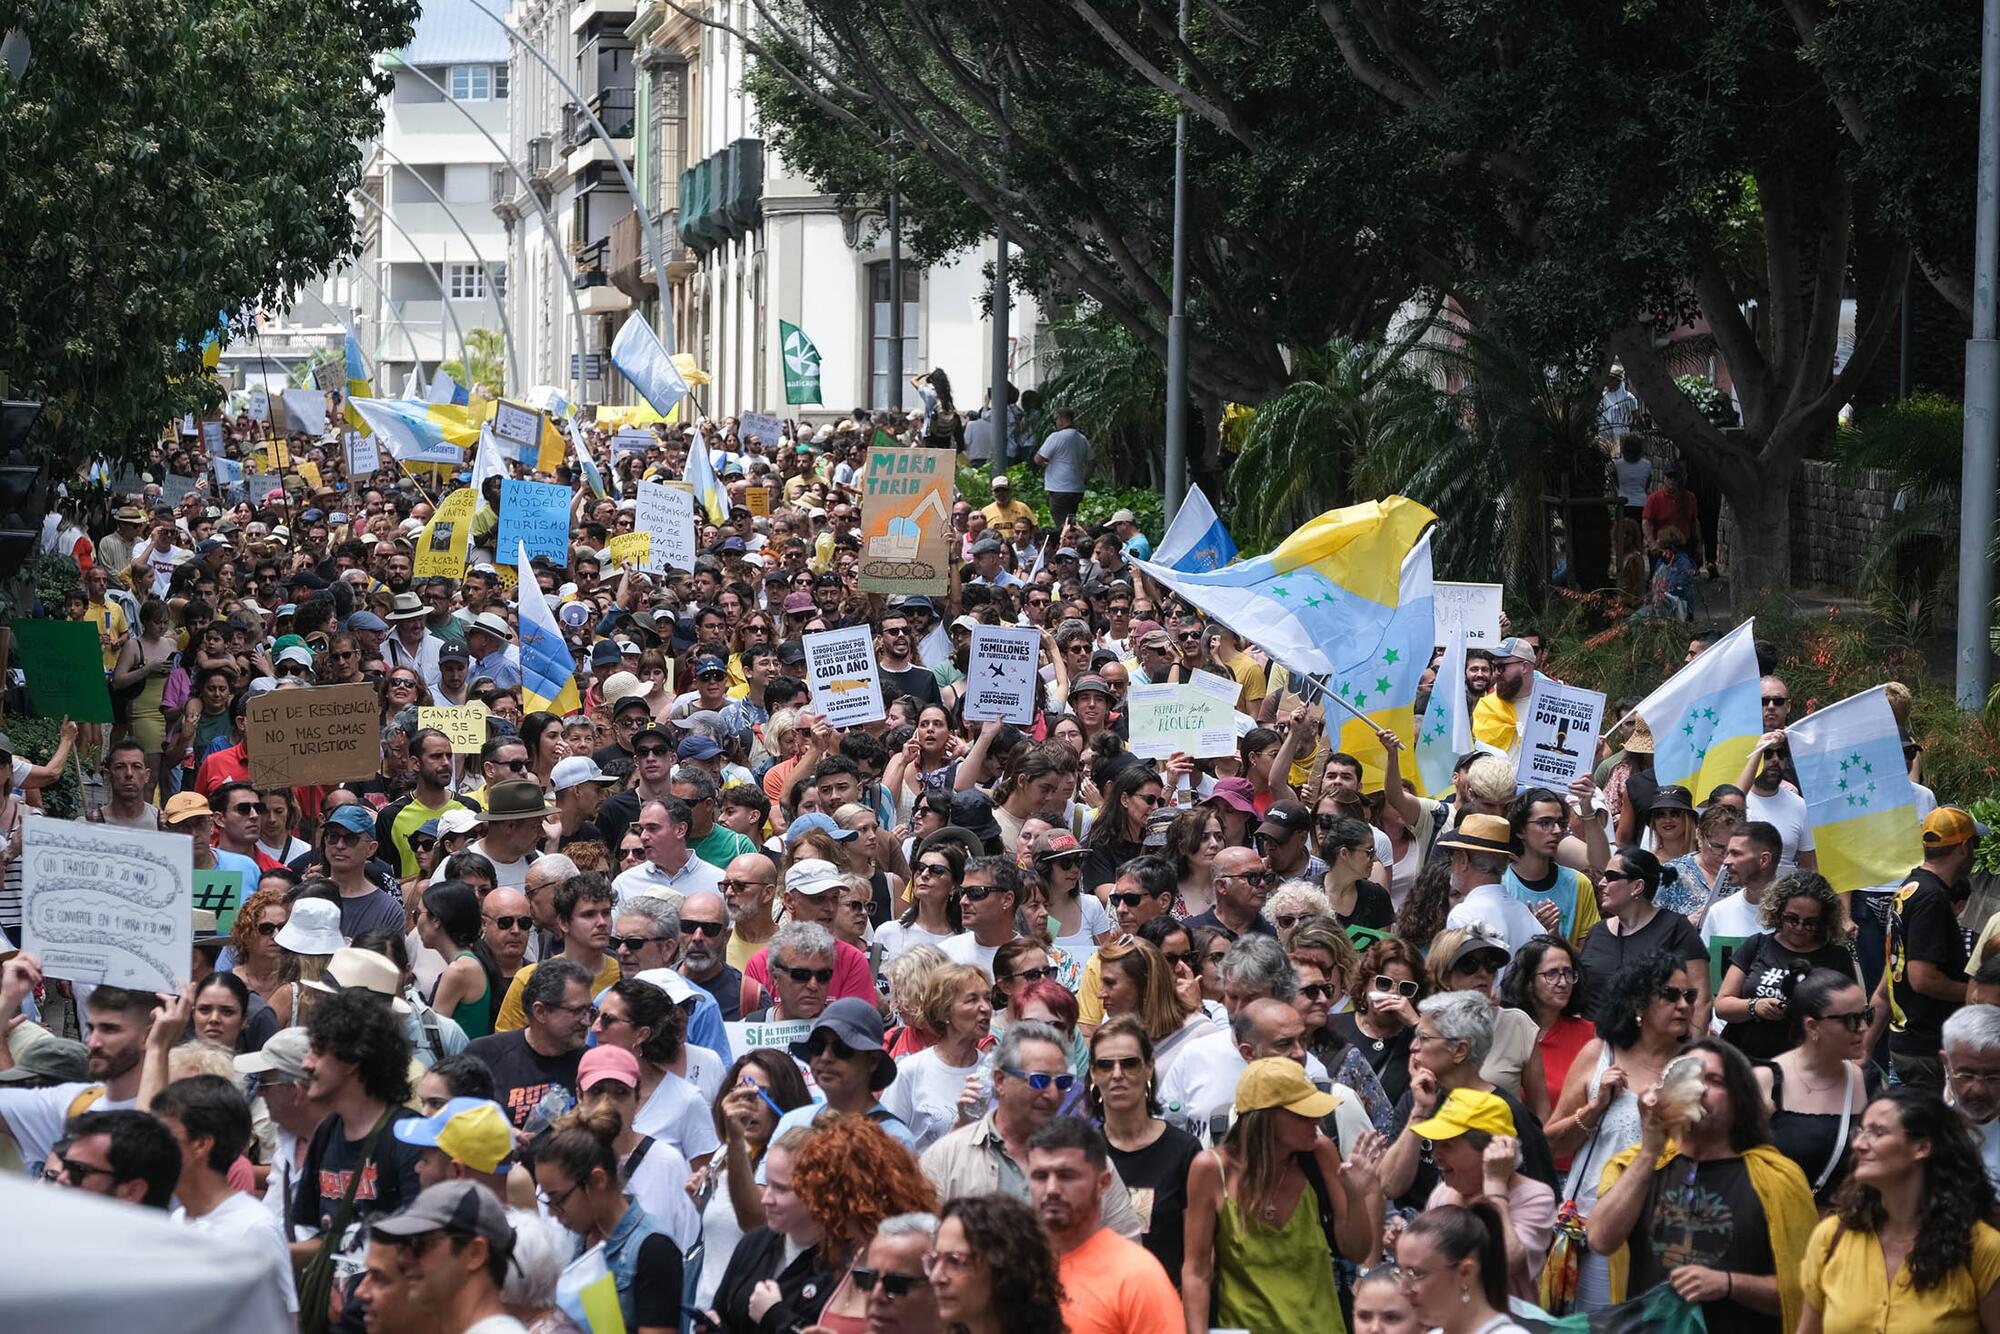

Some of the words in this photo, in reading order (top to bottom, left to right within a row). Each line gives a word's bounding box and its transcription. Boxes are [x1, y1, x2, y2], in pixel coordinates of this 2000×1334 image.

[510, 484, 567, 498] NUEVO
[508, 497, 567, 508] MODELO
[522, 510, 543, 518] DE
[504, 519, 567, 531] TURISMO
[649, 524, 663, 533] NO
[650, 537, 683, 549] ENDE
[419, 556, 429, 565] SE
[432, 556, 459, 565] ACABA
[511, 550, 565, 560] CNTIDAD
[431, 566, 459, 577] JUEGO
[813, 644, 853, 655] ATROPELLADOS
[980, 643, 1030, 655] 16MILLONES
[823, 657, 834, 665] LOS
[848, 652, 868, 660] NACEN
[986, 652, 1010, 660] TURISTAS
[816, 664, 845, 678] CADA
[846, 658, 869, 674] AÑO
[836, 697, 862, 705] OBJETIVO
[980, 698, 1020, 706] SOPORTAR?
[252, 708, 278, 723] LEY
[287, 706, 303, 719] DE
[422, 709, 483, 720] CANARIAS
[1547, 705, 1567, 715] AGUAS
[1568, 709, 1592, 720] FECALES
[451, 722, 468, 731] SE
[1536, 711, 1558, 726] POR
[1572, 718, 1590, 732] DÍA
[265, 730, 285, 743] NO
[296, 727, 321, 740] MAS
[328, 723, 366, 735] CAMAS
[1533, 762, 1575, 777] VERTER?
[1547, 760, 1576, 770] PODEMOS
[43, 858, 57, 873] UN
[62, 859, 100, 877] TRAYECTO
[105, 864, 114, 880] DE
[45, 908, 55, 923] SE
[57, 909, 92, 926] CONVIERTE
[98, 914, 110, 927] EN
[745, 1026, 763, 1046] SÍ
[765, 1028, 775, 1037] AL
[775, 1024, 811, 1036] TURISMO
